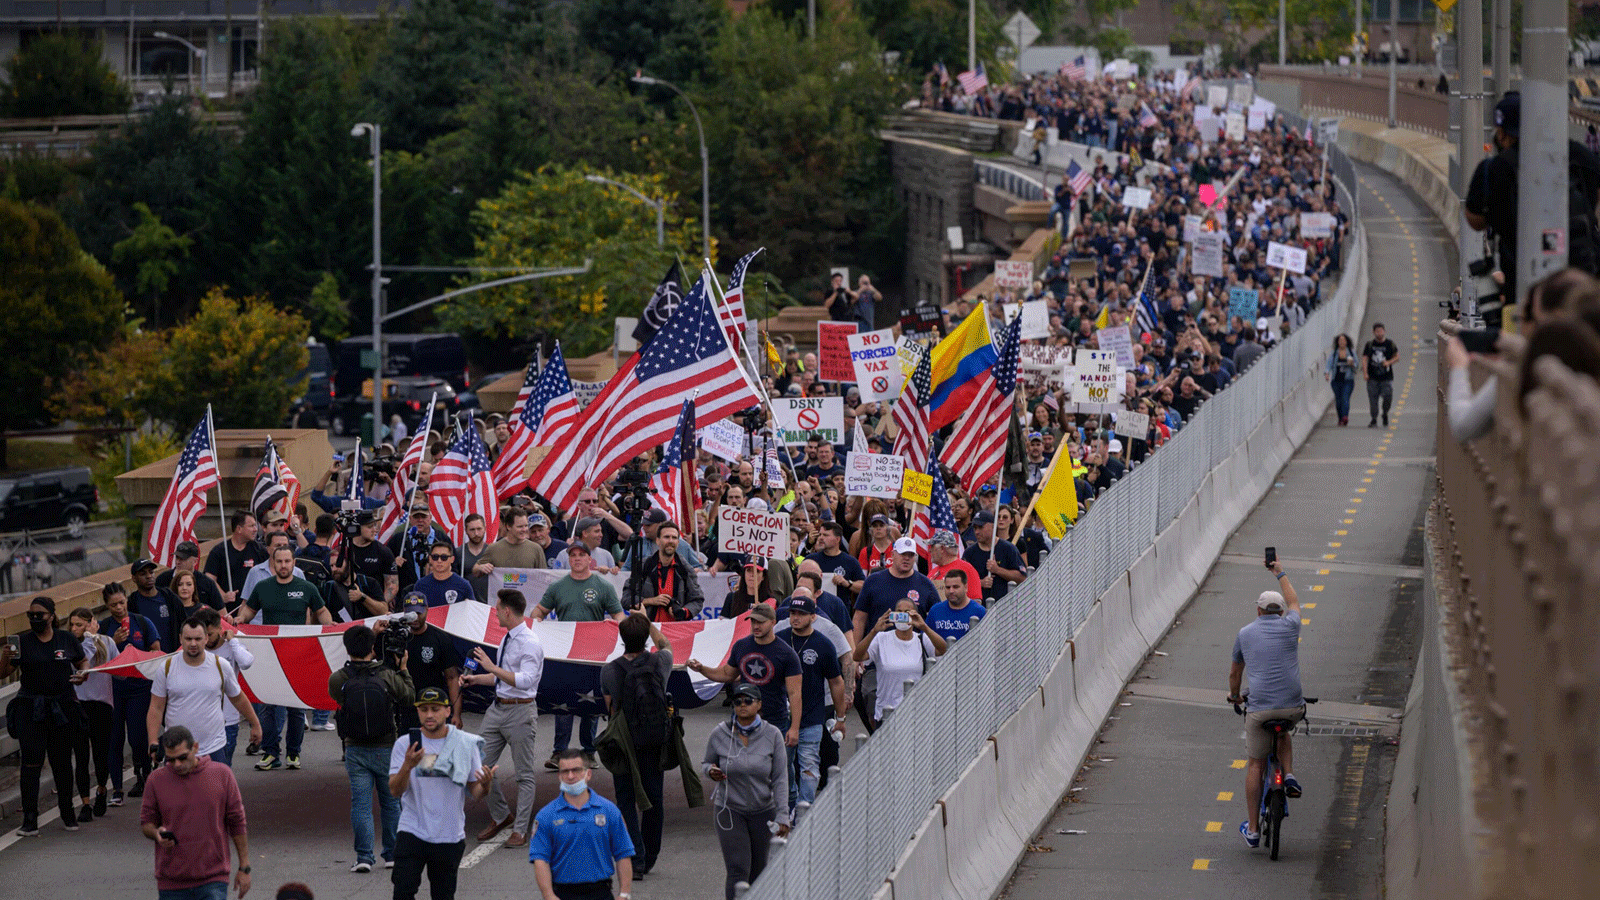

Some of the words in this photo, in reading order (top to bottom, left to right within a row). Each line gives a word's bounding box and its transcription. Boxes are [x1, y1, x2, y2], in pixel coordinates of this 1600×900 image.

[861, 334, 880, 346] NO
[851, 346, 896, 362] FORCED
[864, 360, 889, 373] VAX
[1098, 363, 1111, 373] THE
[1088, 386, 1109, 398] NOT
[790, 398, 824, 410] DSNY
[709, 424, 742, 445] HEROES
[875, 457, 889, 465] NO
[906, 486, 929, 498] JESUS
[722, 509, 783, 530] COERCION
[732, 524, 745, 537] IS
[749, 528, 778, 542] NOT
[725, 539, 775, 557] CHOICE
